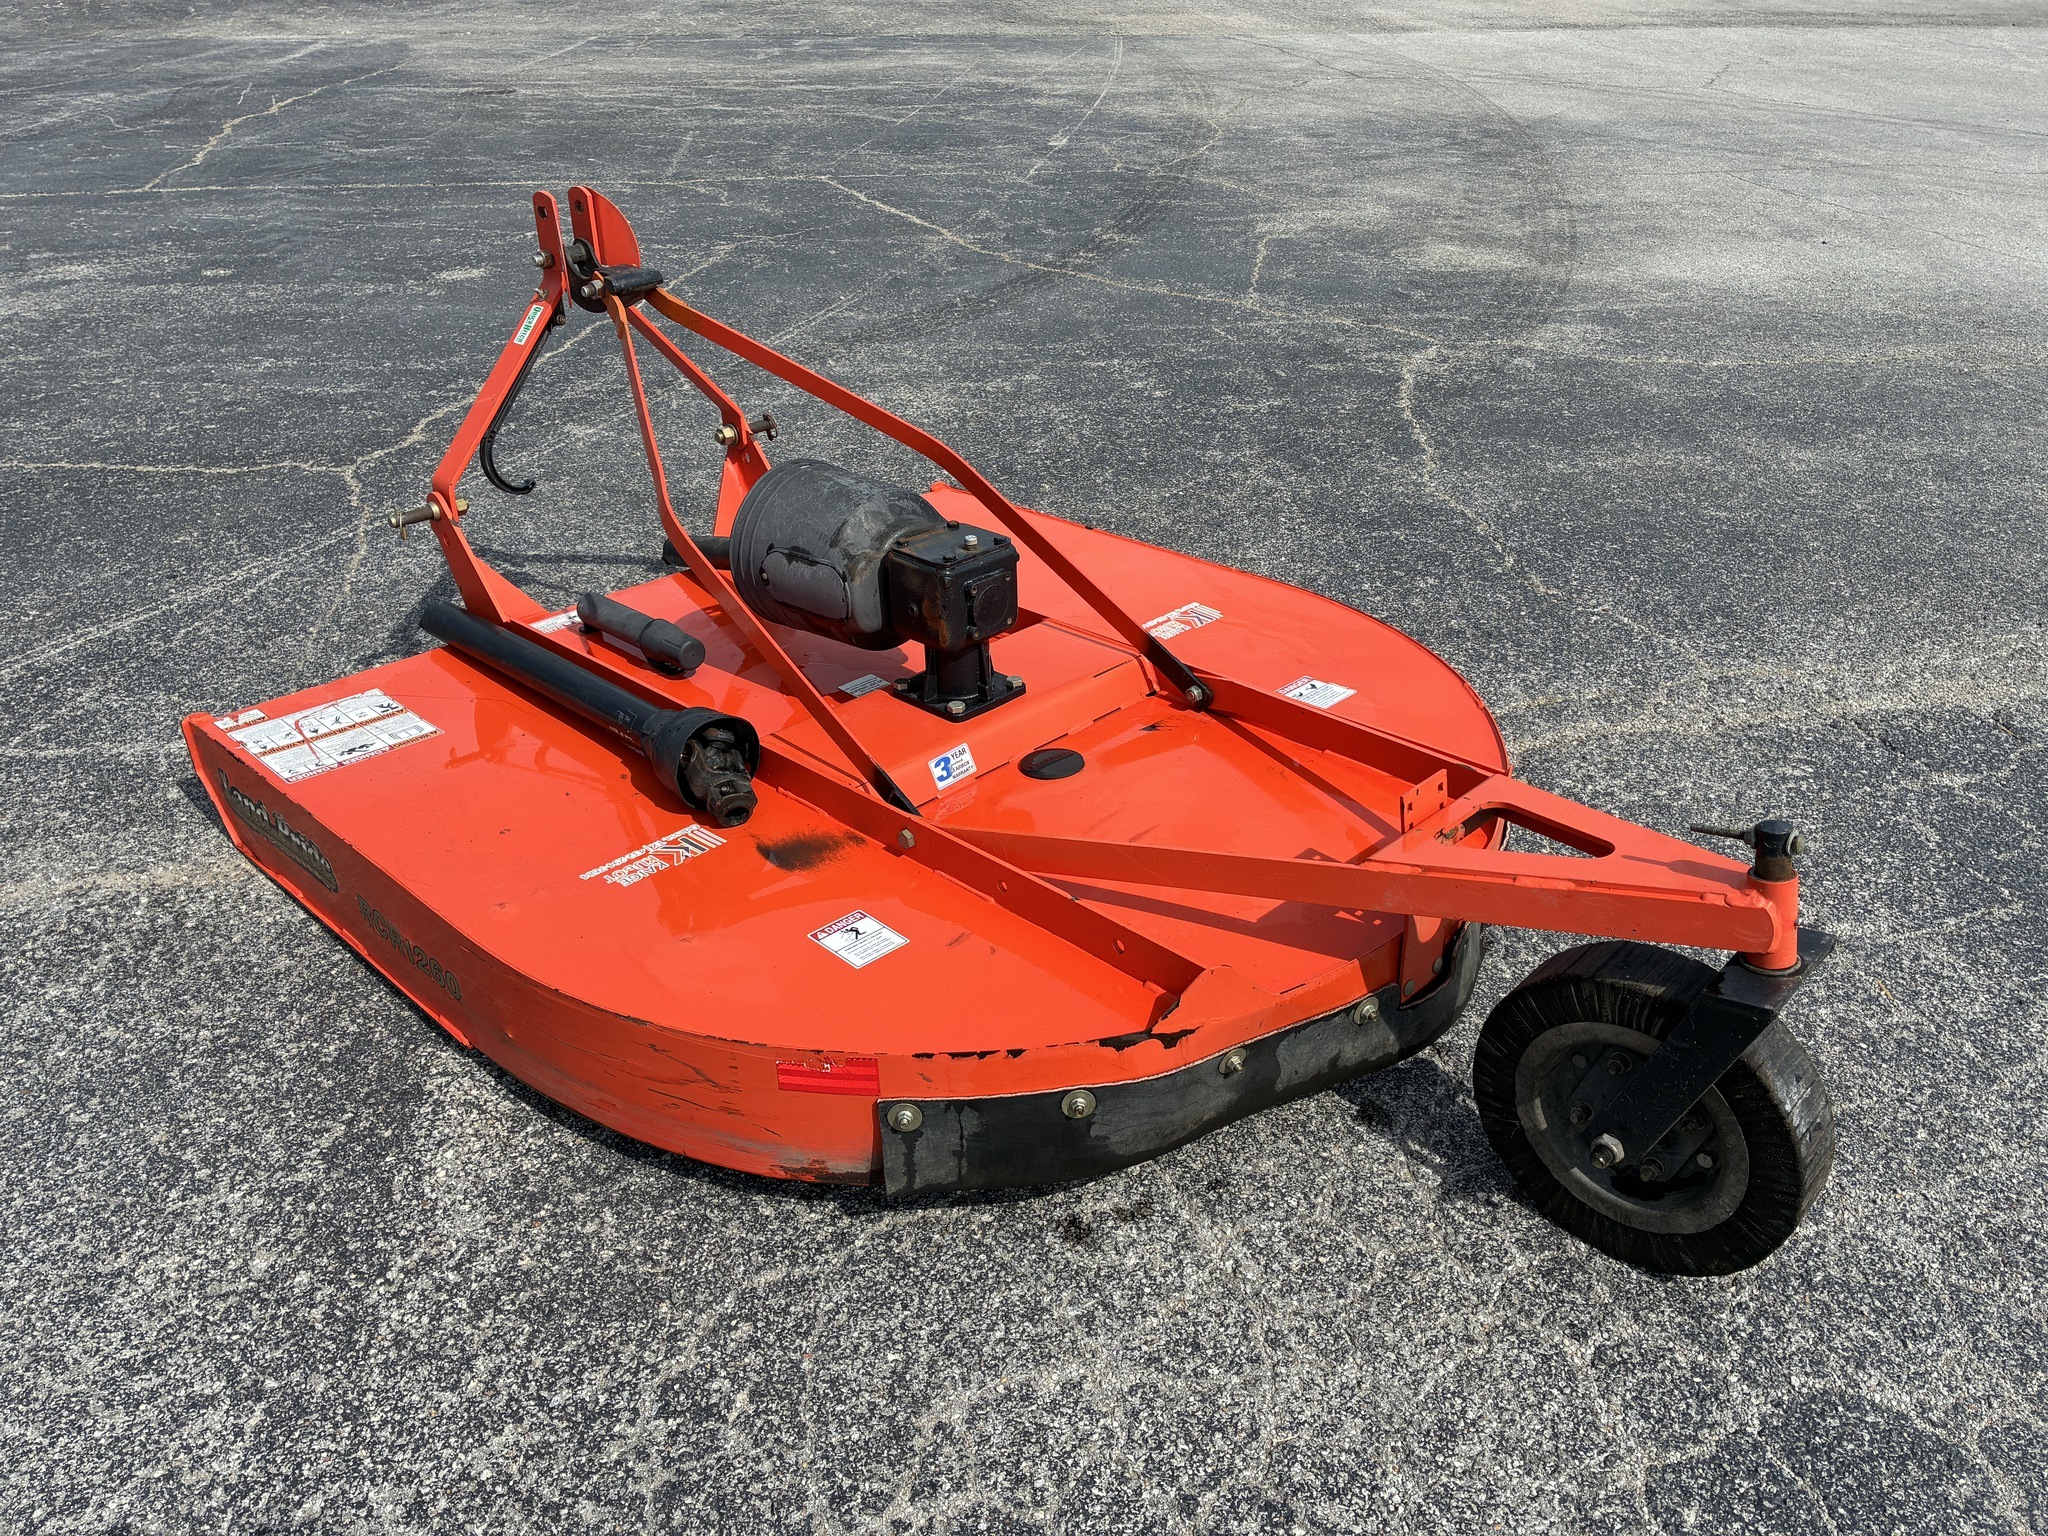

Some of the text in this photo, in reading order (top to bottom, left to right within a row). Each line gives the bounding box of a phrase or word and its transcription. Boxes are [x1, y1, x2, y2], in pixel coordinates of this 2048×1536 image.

[393, 731, 432, 749] WARNING
[343, 749, 384, 767] DANGER
[934, 747, 967, 782] 3 YEAR
[288, 766, 329, 783] DANGER
[952, 765, 974, 780] WARRANTY
[218, 768, 271, 828] Land
[272, 811, 333, 876] Pride
[824, 912, 865, 935] DANGER
[356, 892, 462, 1003] RCR1260
